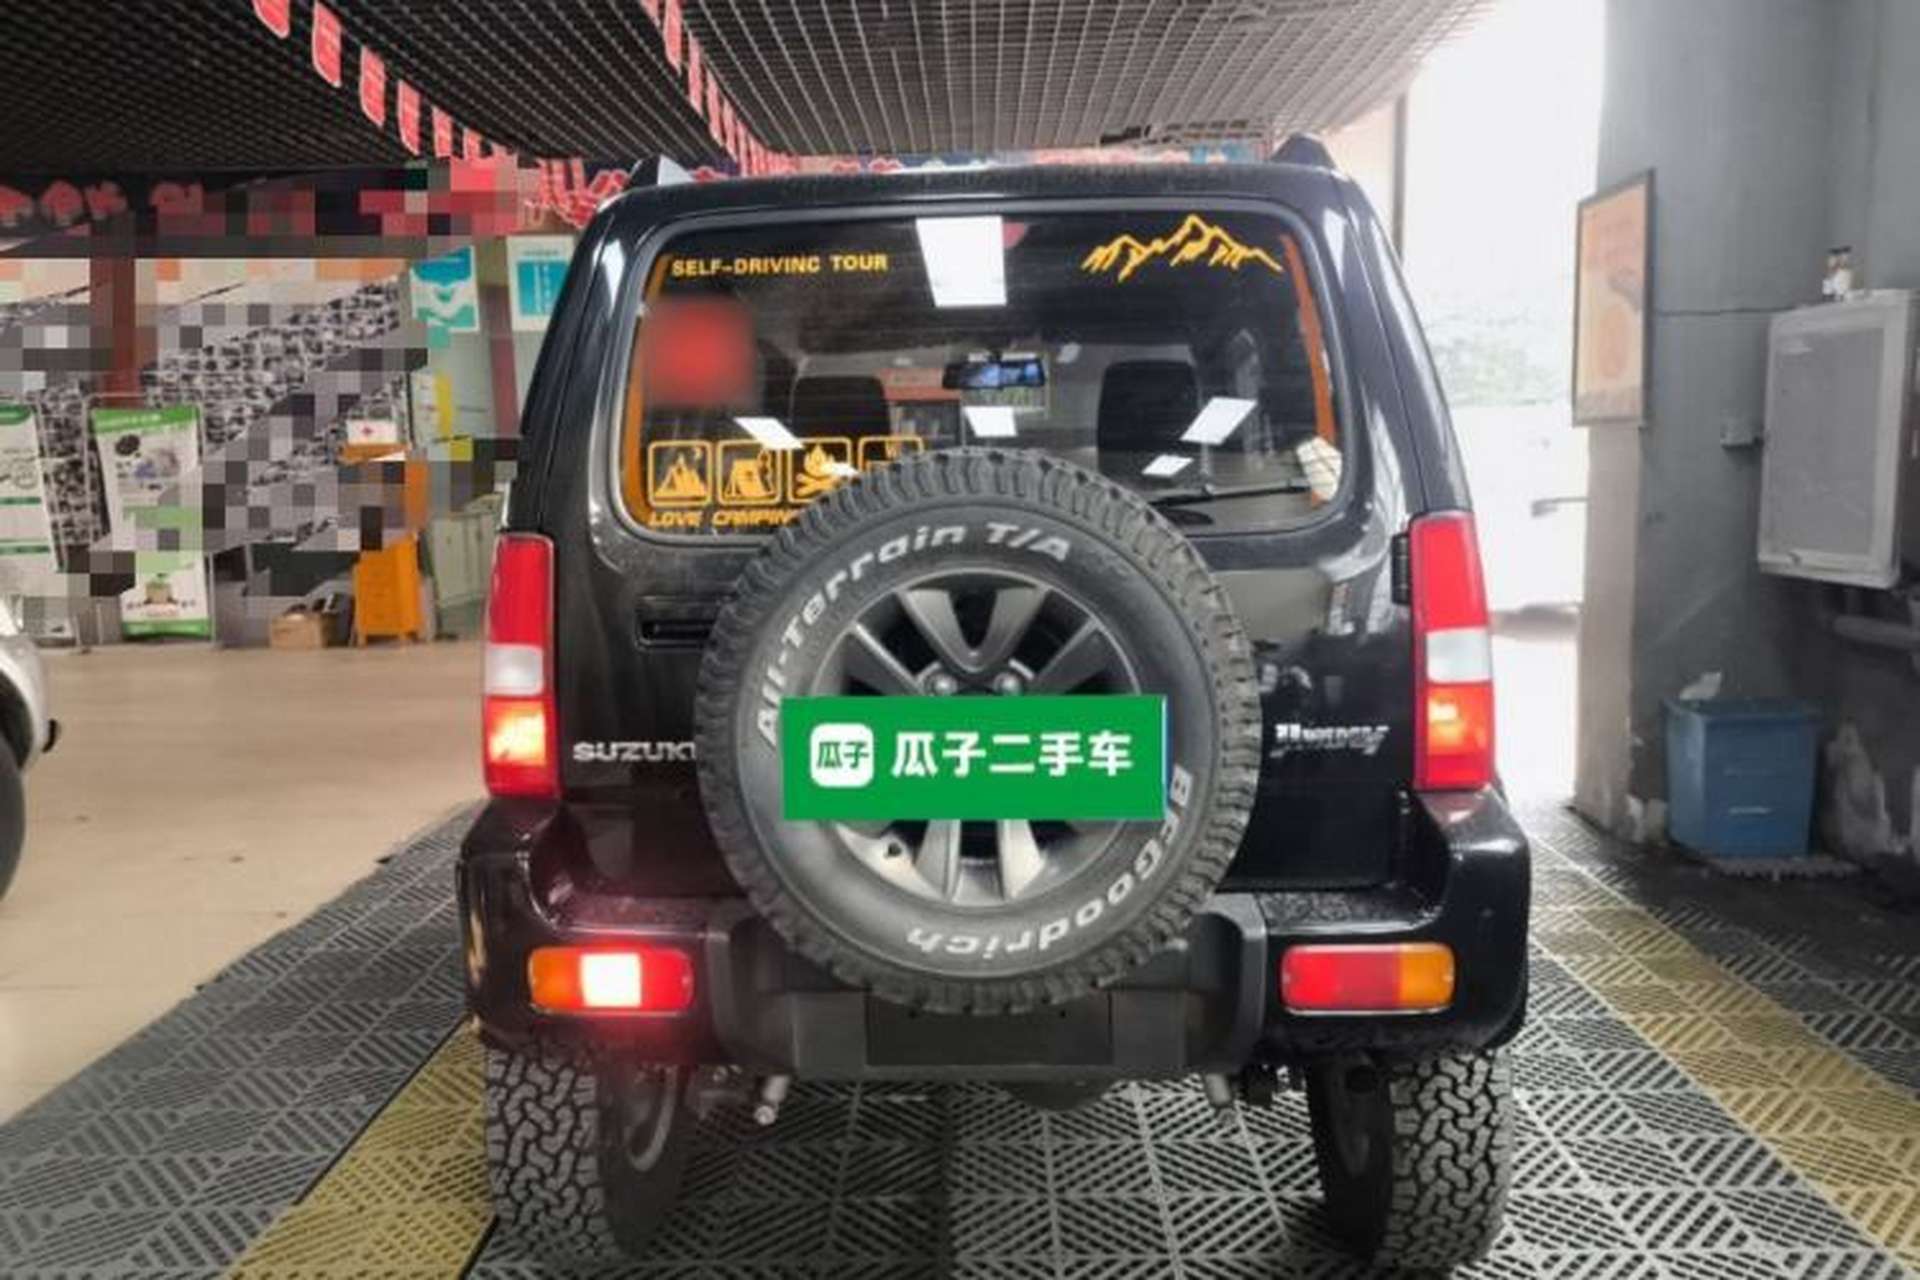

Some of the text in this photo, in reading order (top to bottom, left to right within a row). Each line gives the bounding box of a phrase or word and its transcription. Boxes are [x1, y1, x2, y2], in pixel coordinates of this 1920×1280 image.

[829, 253, 889, 273] TOUR
[648, 509, 803, 529] LOVE CAMPIN
[985, 522, 1072, 562] T/A
[906, 764, 1194, 959] BFGoodrich
